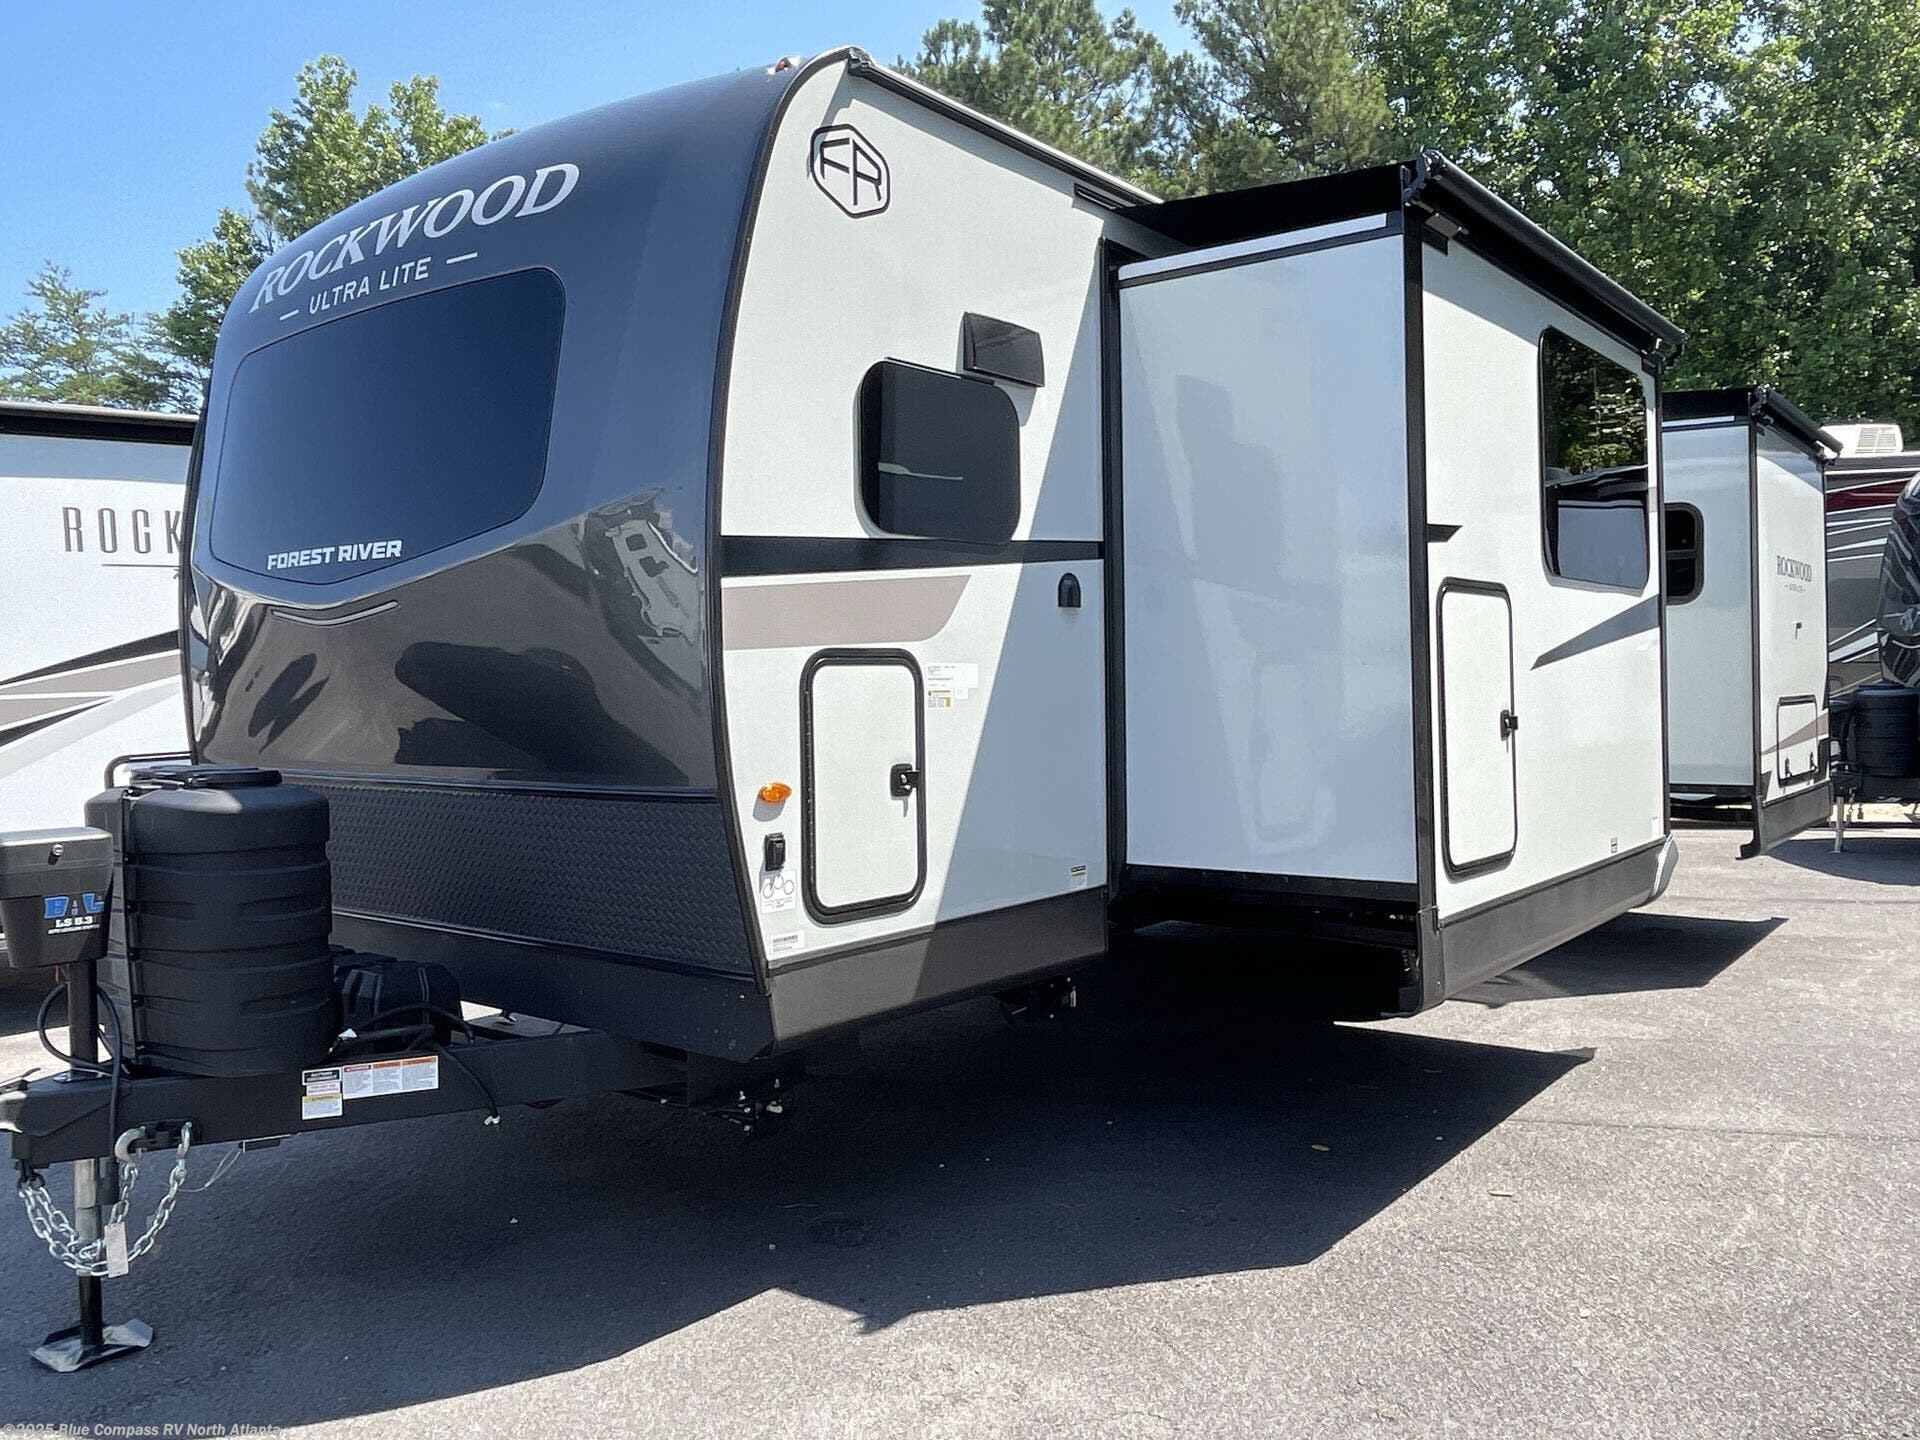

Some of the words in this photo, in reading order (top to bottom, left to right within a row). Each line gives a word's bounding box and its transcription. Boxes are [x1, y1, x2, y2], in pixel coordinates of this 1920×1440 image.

[249, 163, 580, 314] ROCKWOOD
[309, 276, 370, 314] ULTRA
[380, 257, 432, 292] LITE
[267, 547, 335, 571] FOREST
[338, 540, 403, 562] RIVER
